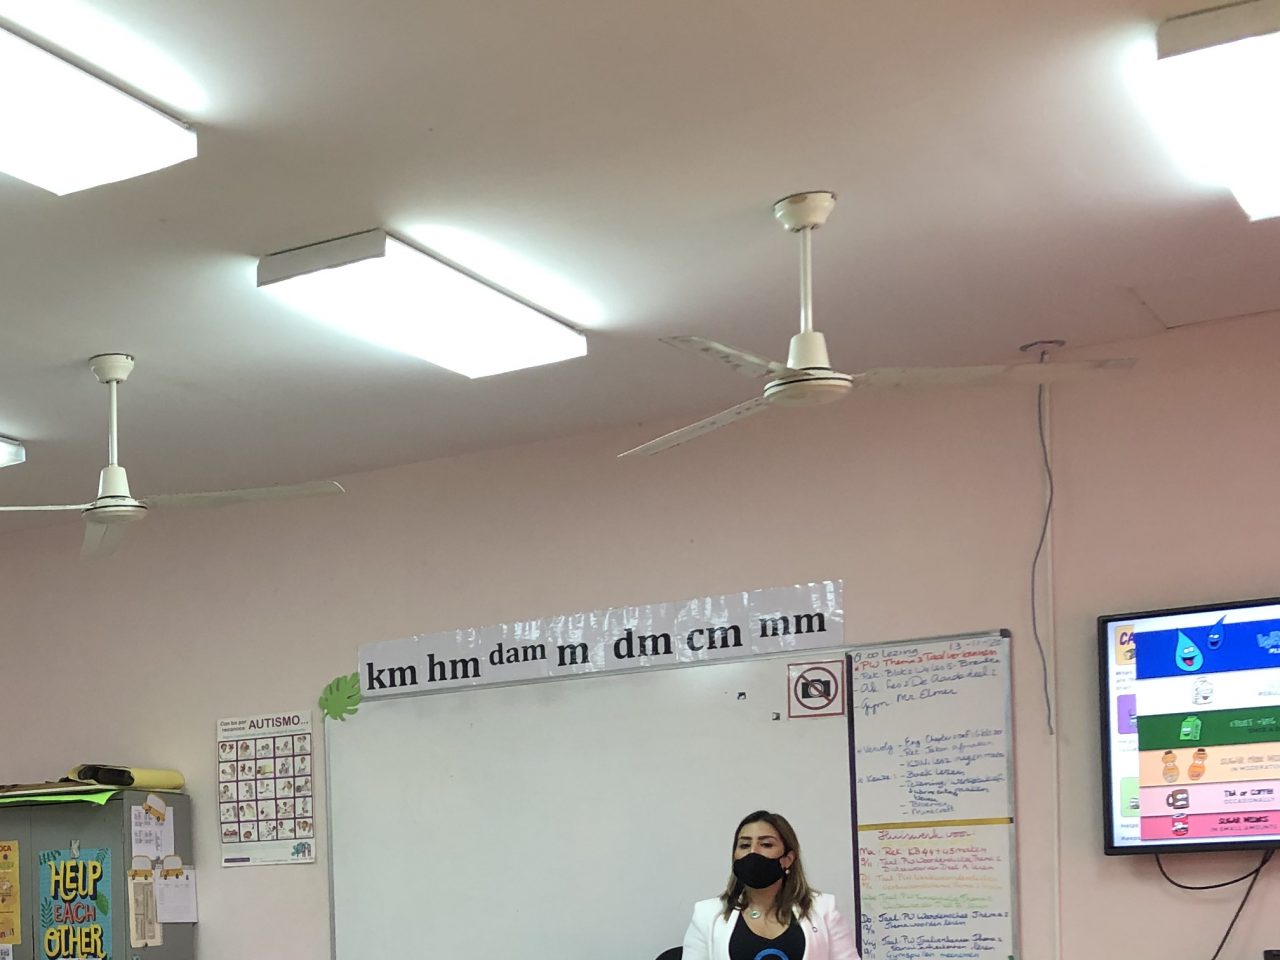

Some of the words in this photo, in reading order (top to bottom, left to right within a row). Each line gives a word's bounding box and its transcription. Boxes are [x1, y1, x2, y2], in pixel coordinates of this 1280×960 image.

[365, 662, 418, 692] km
[426, 653, 482, 683] hm
[488, 642, 548, 667] dam
[557, 642, 589, 667] m
[613, 627, 673, 661] dm
[686, 623, 743, 652] cm
[758, 611, 827, 639] mm
[48, 859, 104, 901] HELP
[53, 900, 97, 924] EACH
[43, 923, 108, 960] OTHER
